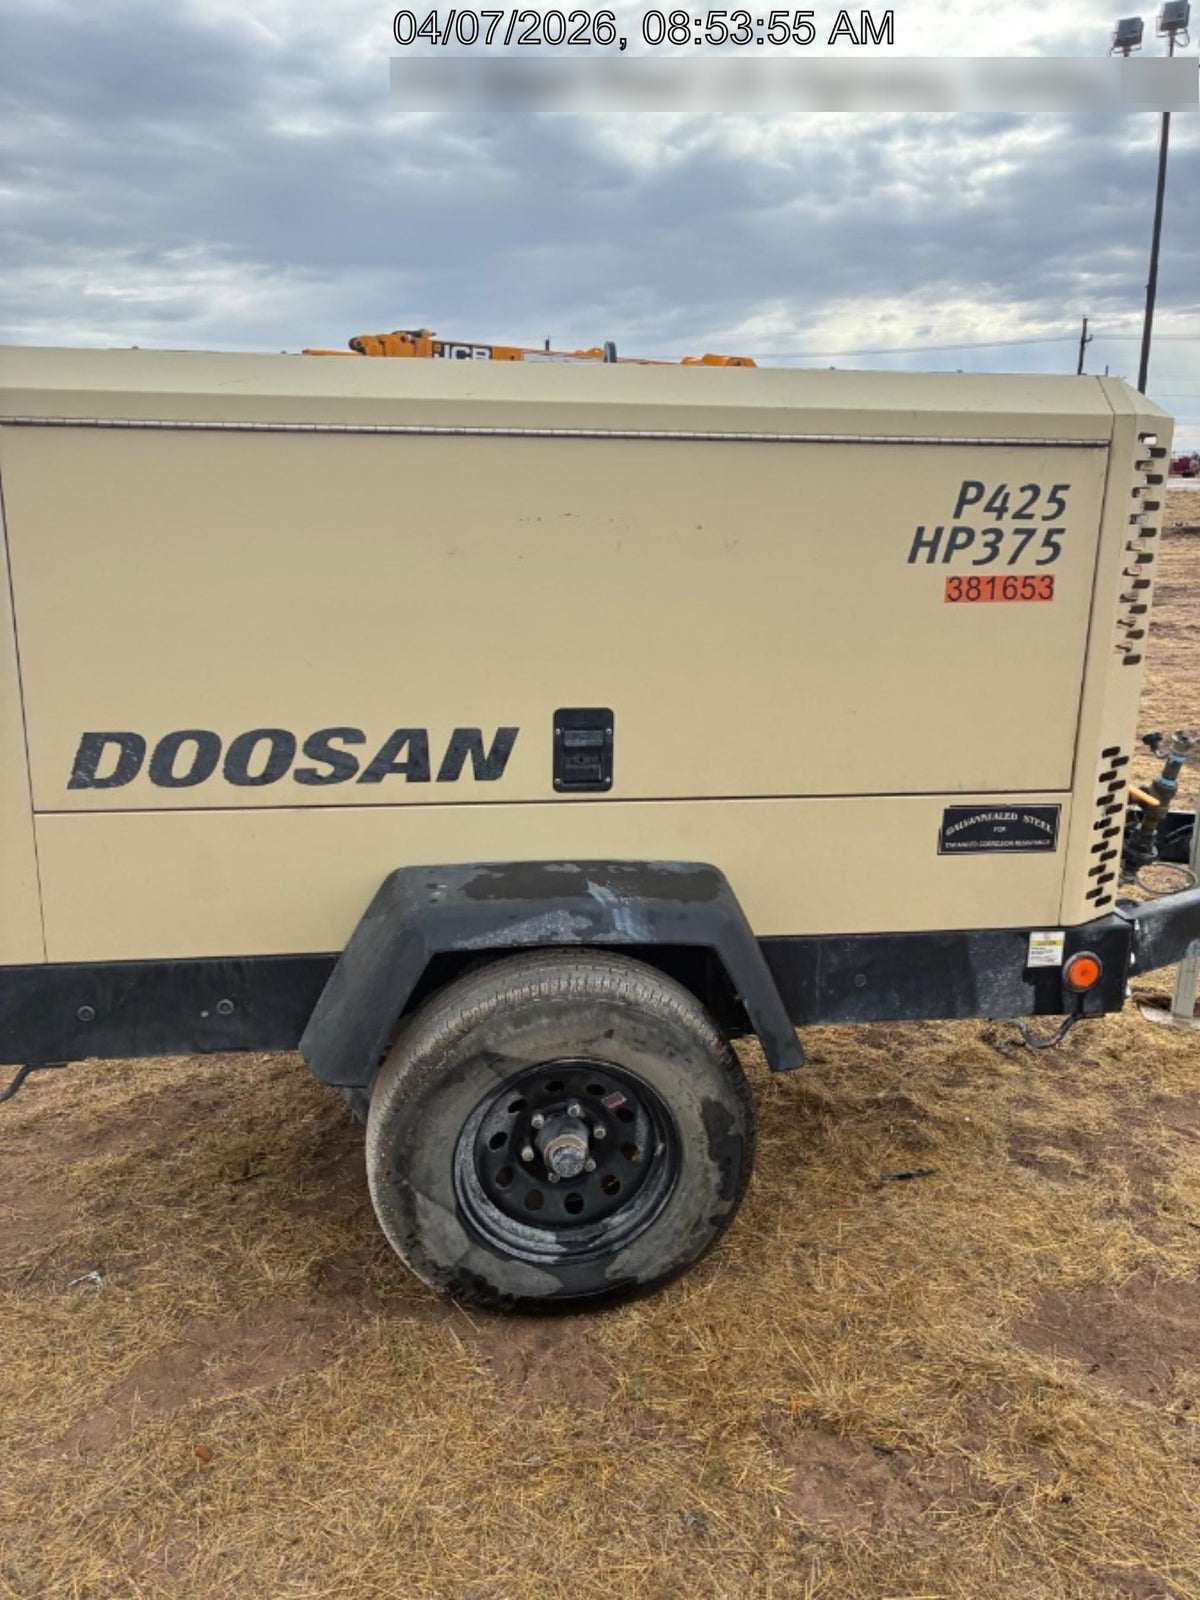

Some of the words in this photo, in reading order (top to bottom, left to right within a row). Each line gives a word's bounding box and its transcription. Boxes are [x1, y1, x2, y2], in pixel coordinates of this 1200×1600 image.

[952, 480, 1071, 521] P425
[907, 526, 1066, 566] HP375
[947, 574, 1054, 601] 381653
[67, 726, 520, 789] DOOSAN
